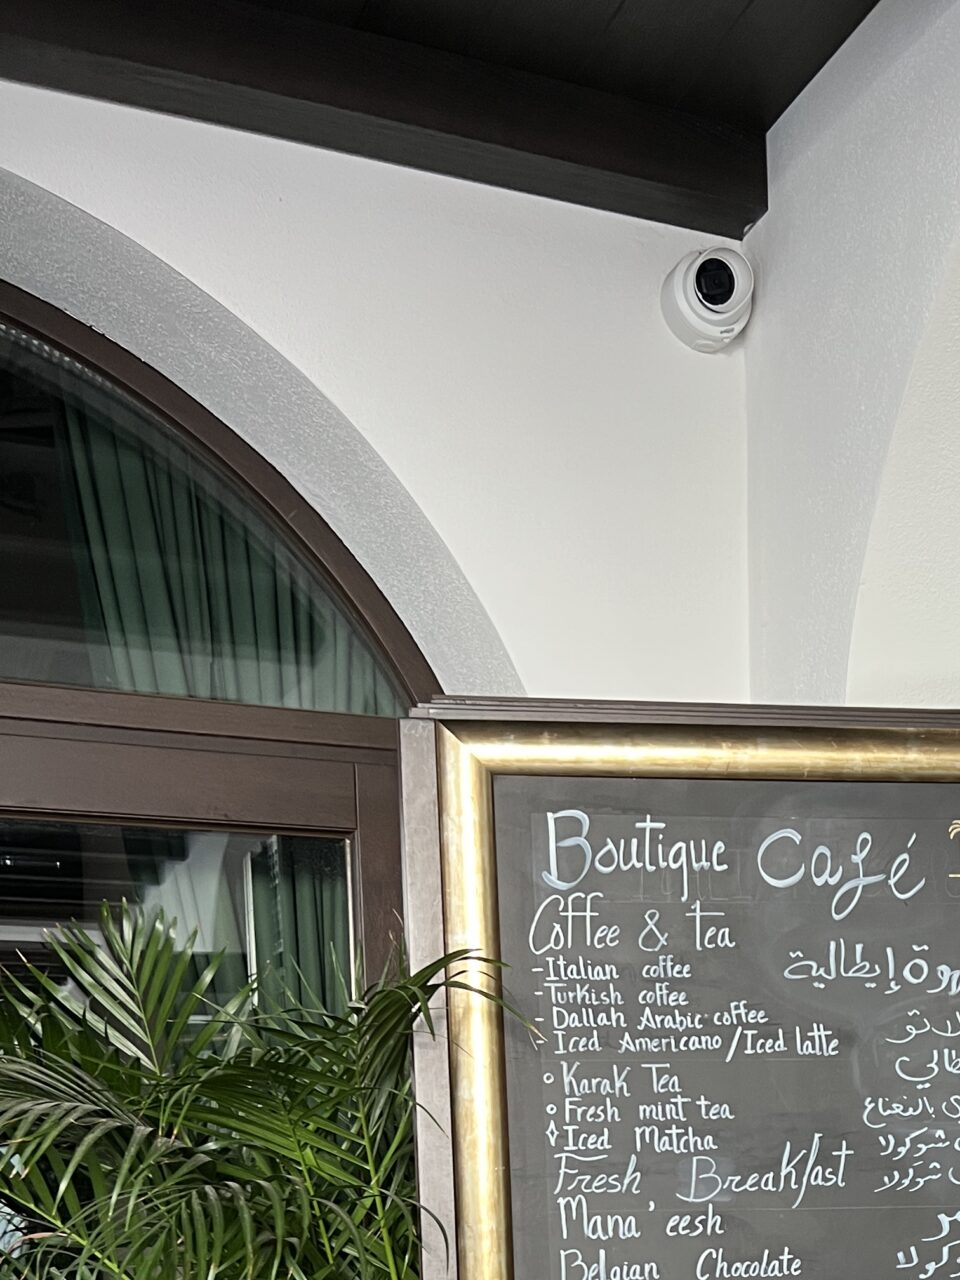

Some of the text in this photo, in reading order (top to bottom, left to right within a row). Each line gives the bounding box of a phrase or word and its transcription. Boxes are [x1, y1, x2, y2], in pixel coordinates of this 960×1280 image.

[541, 808, 926, 921] Boutique Café
[528, 892, 620, 955] Coffee
[638, 909, 668, 952] &
[641, 954, 692, 979] coffee
[783, 938, 902, 995] إيطالية
[638, 982, 689, 1007] coffee
[552, 1000, 769, 1032] Dallah Arabic coffee
[553, 1029, 602, 1055] Iced
[795, 1022, 840, 1057] latte
[641, 1063, 683, 1093] Tea
[564, 1094, 735, 1123] Fresh mint tea
[563, 1124, 719, 1153] Iced Matcha
[553, 1152, 642, 1196] Fresh
[696, 1246, 802, 1280] Chocolate
